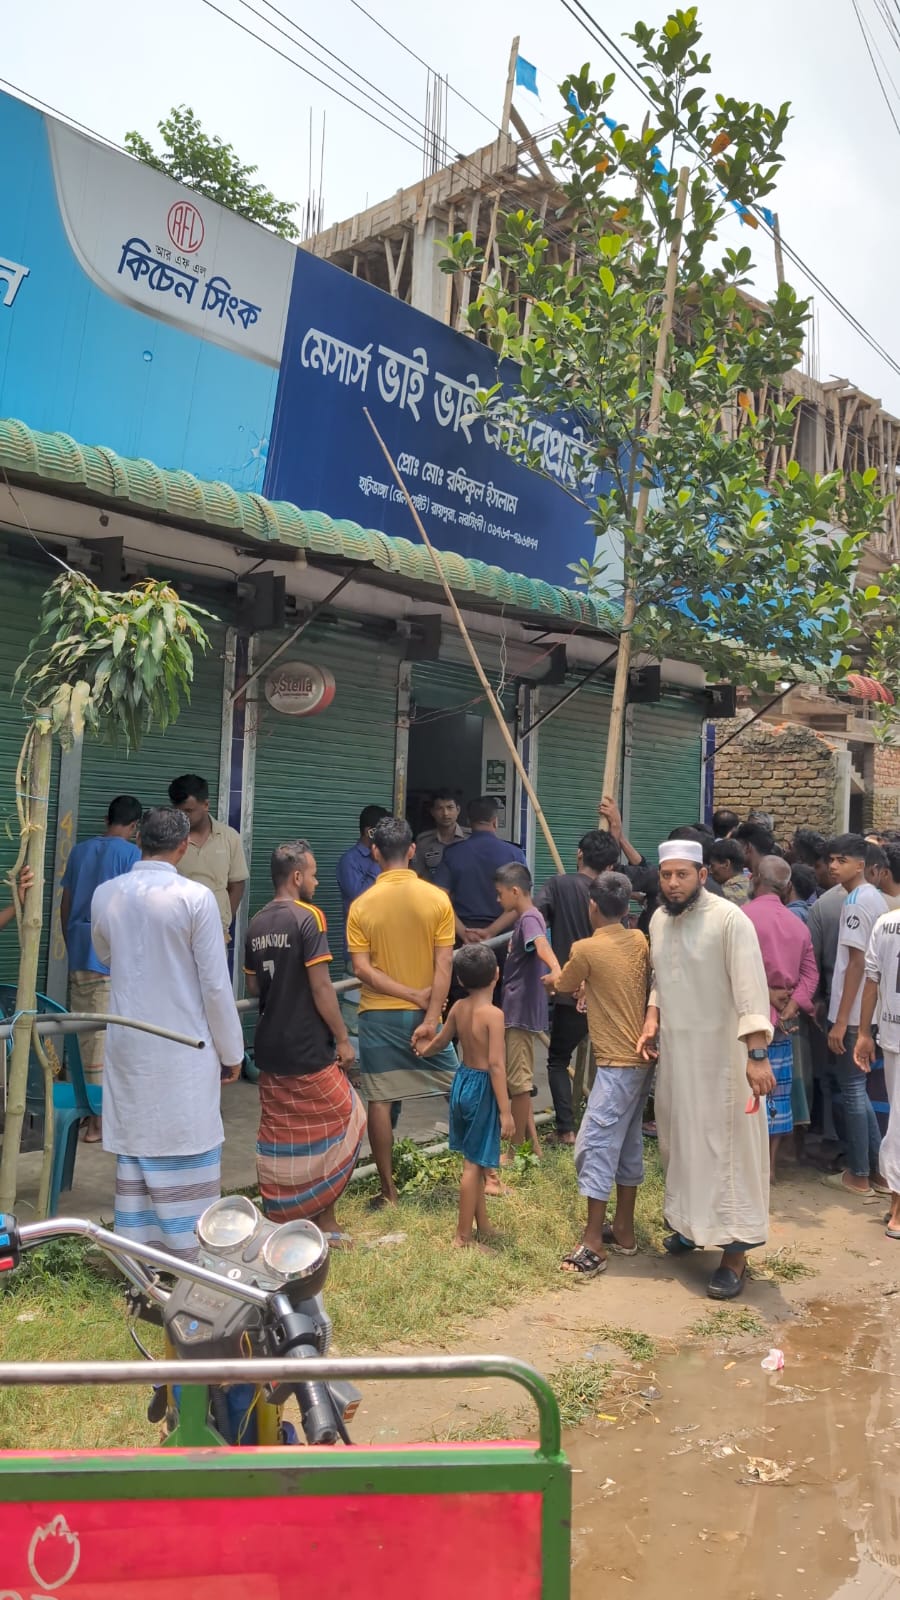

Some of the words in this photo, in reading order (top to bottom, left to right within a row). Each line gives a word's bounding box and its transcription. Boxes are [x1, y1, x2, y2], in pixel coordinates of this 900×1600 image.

[171, 204, 200, 250] RFL
[155, 245, 172, 262] আর
[174, 256, 190, 270] এফ
[117, 237, 199, 304] কিচেন
[201, 276, 262, 330] সিংক
[300, 327, 374, 392] মেসার্স
[377, 344, 428, 422] ভাই
[446, 467, 486, 506] রফিকুল
[486, 481, 519, 514] ইসলাম
[279, 678, 313, 693] Stella
